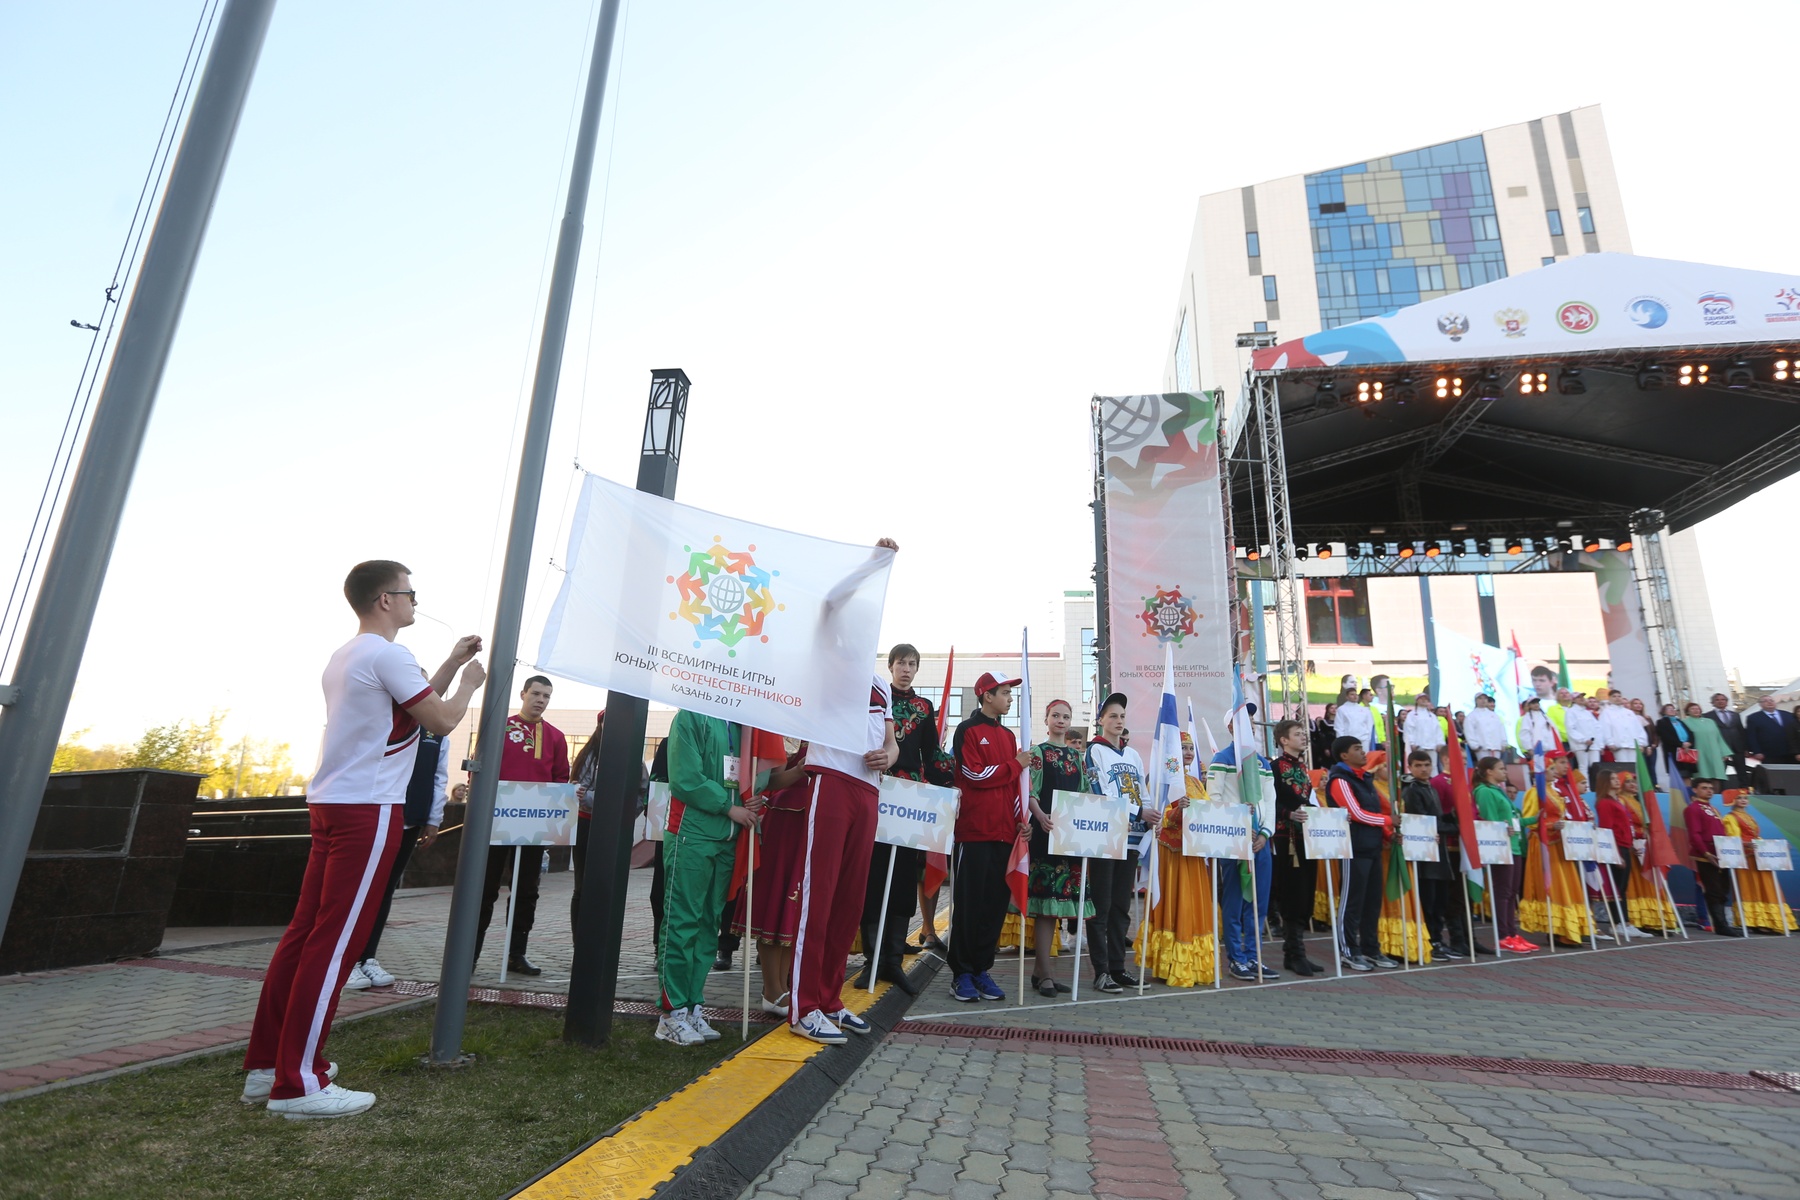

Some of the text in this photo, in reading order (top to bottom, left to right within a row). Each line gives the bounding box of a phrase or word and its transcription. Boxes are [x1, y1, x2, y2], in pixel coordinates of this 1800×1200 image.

[661, 649, 739, 678] ВСЕМИРНЫЕ
[742, 669, 776, 687] ИГРЫ
[614, 651, 802, 707] ЮНЫХ СООТЕЧЕСТВЕННИКОВ
[671, 683, 742, 708] КАЗАНЬ 2017
[493, 807, 570, 819] КСЕМБУРГ
[878, 802, 938, 824] СТОНИЯ
[1072, 818, 1109, 833] ЧЕХИЯ
[1188, 822, 1247, 837] ФИНЛЯНДИЯ
[1308, 828, 1347, 838] УЗБЕКИСТАН
[1566, 836, 1594, 845] СЛОВЕНИЯ
